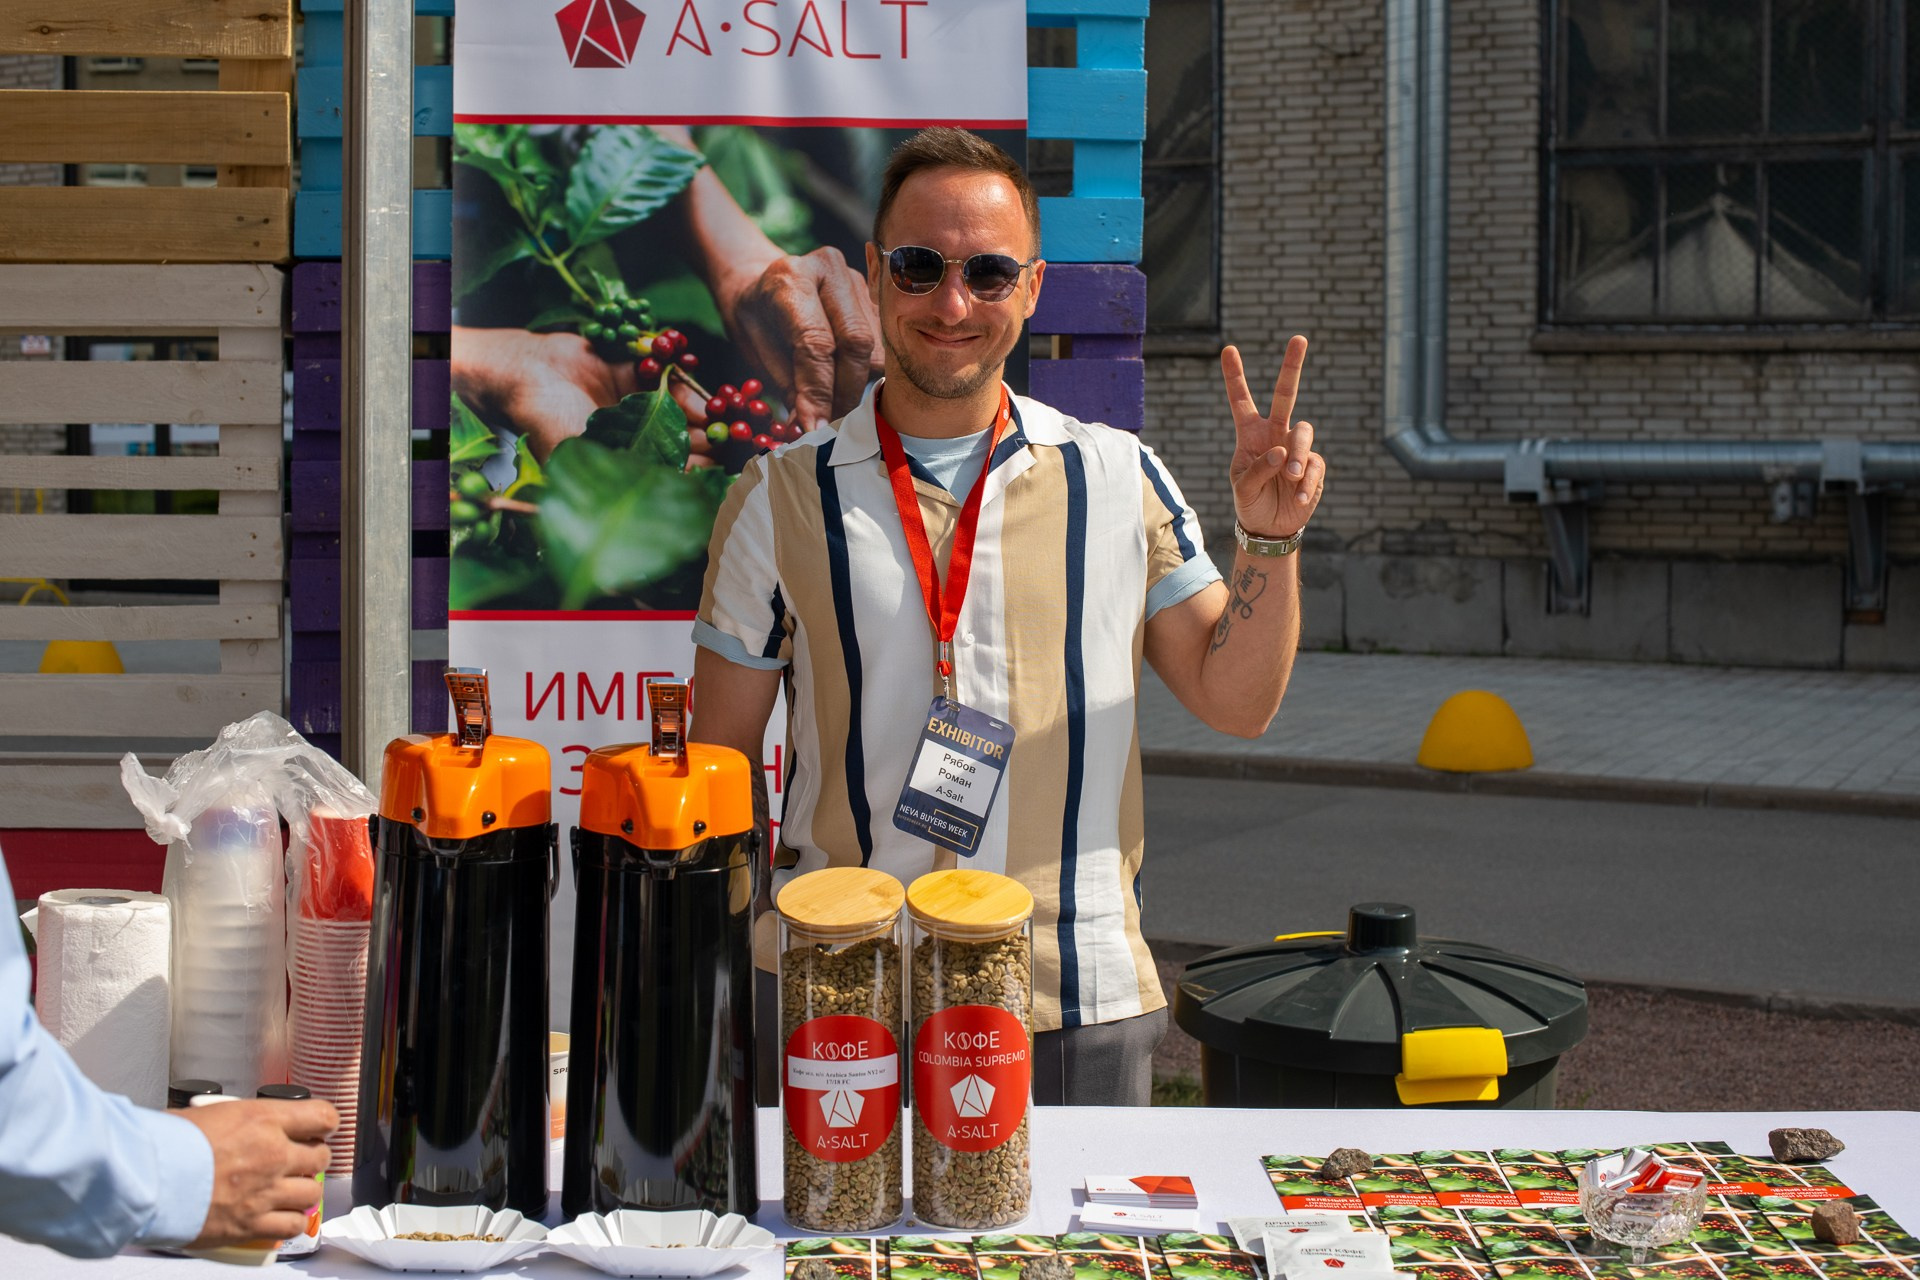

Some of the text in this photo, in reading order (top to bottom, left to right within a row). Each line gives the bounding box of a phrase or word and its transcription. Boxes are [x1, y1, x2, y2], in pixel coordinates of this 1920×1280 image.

[525, 671, 696, 721] ИМП
[928, 717, 1004, 759] EXHIBITOR
[943, 753, 976, 774] Рябов
[938, 767, 972, 788] Роман
[936, 785, 964, 803] A-Salt
[900, 804, 919, 818] NEVA
[920, 811, 948, 829] BUYERS
[948, 823, 968, 838] WEEK
[812, 1040, 869, 1060] КОФЕ
[944, 1031, 1000, 1050] КОФЕ
[919, 1050, 1025, 1067] COLOMBIA SUPREMO
